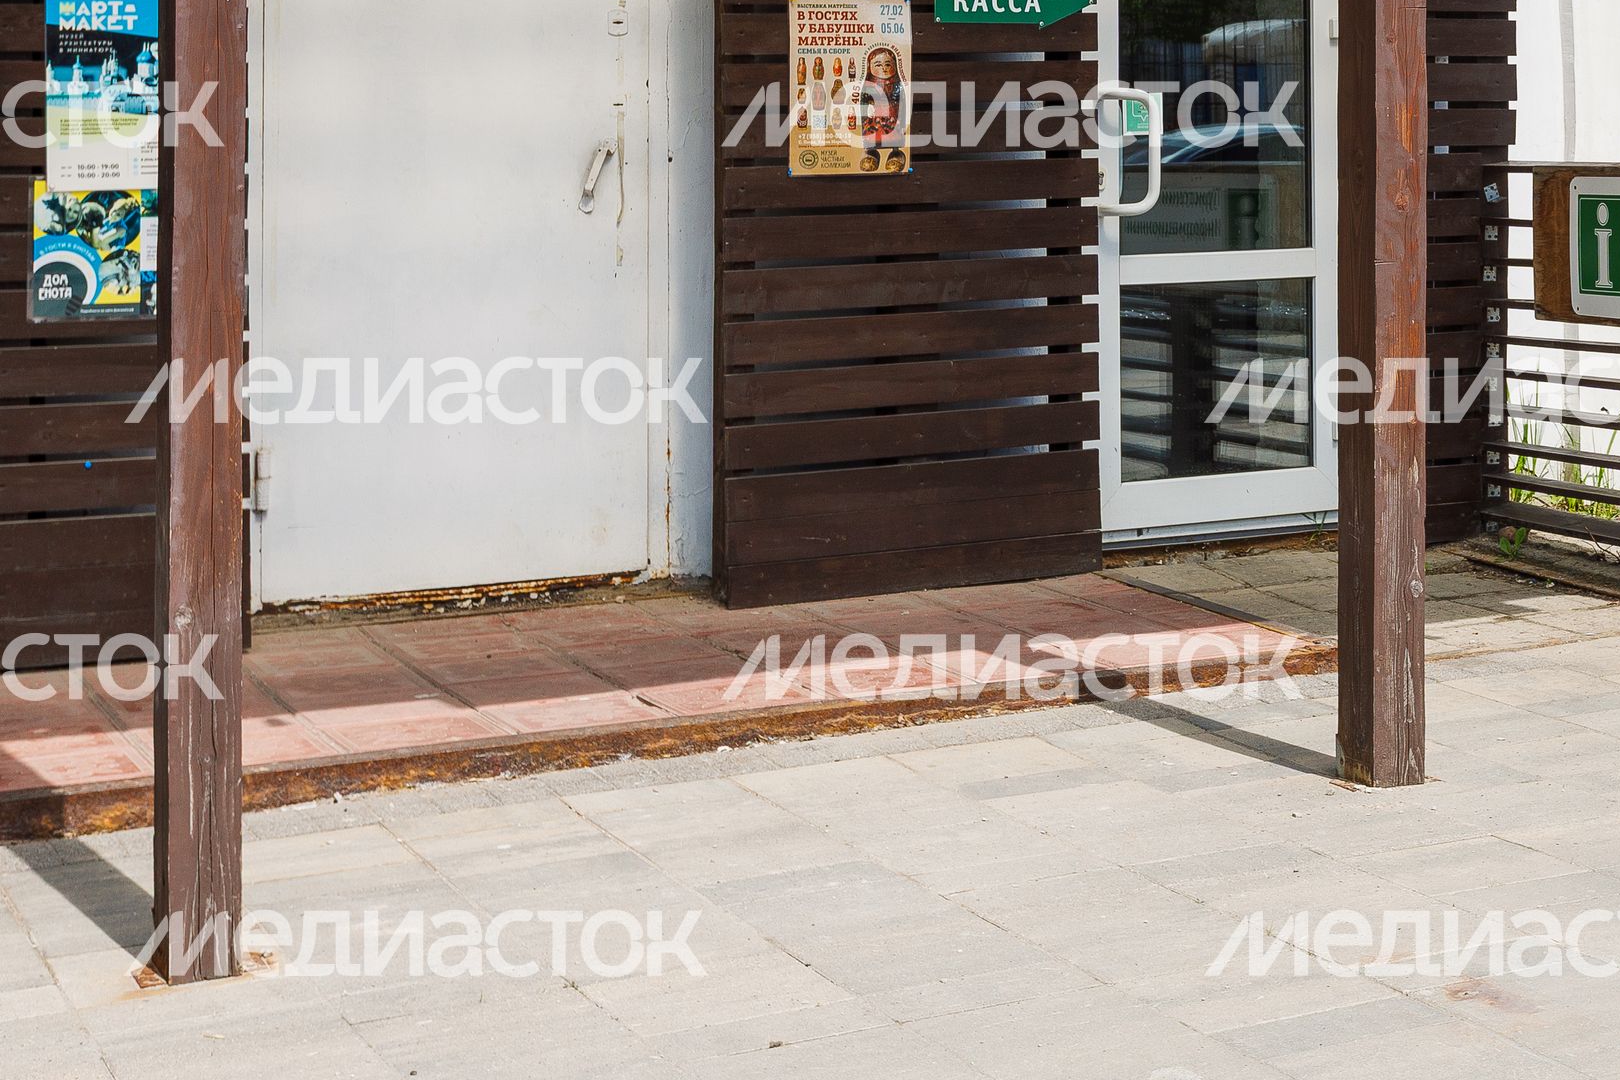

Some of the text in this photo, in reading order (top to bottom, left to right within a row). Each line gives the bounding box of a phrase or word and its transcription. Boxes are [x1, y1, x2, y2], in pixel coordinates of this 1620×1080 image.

[797, 11, 858, 21] В ГОСТЯХ
[880, 4, 903, 16] 27.02
[59, 15, 138, 31] МАКЕТ
[797, 23, 875, 34] У БАБУШКИ
[881, 23, 904, 34] 05.06
[797, 34, 867, 47] МАТРЁНЫ.
[43, 274, 69, 288] ДОМ
[38, 286, 72, 300] ЕНОТА
